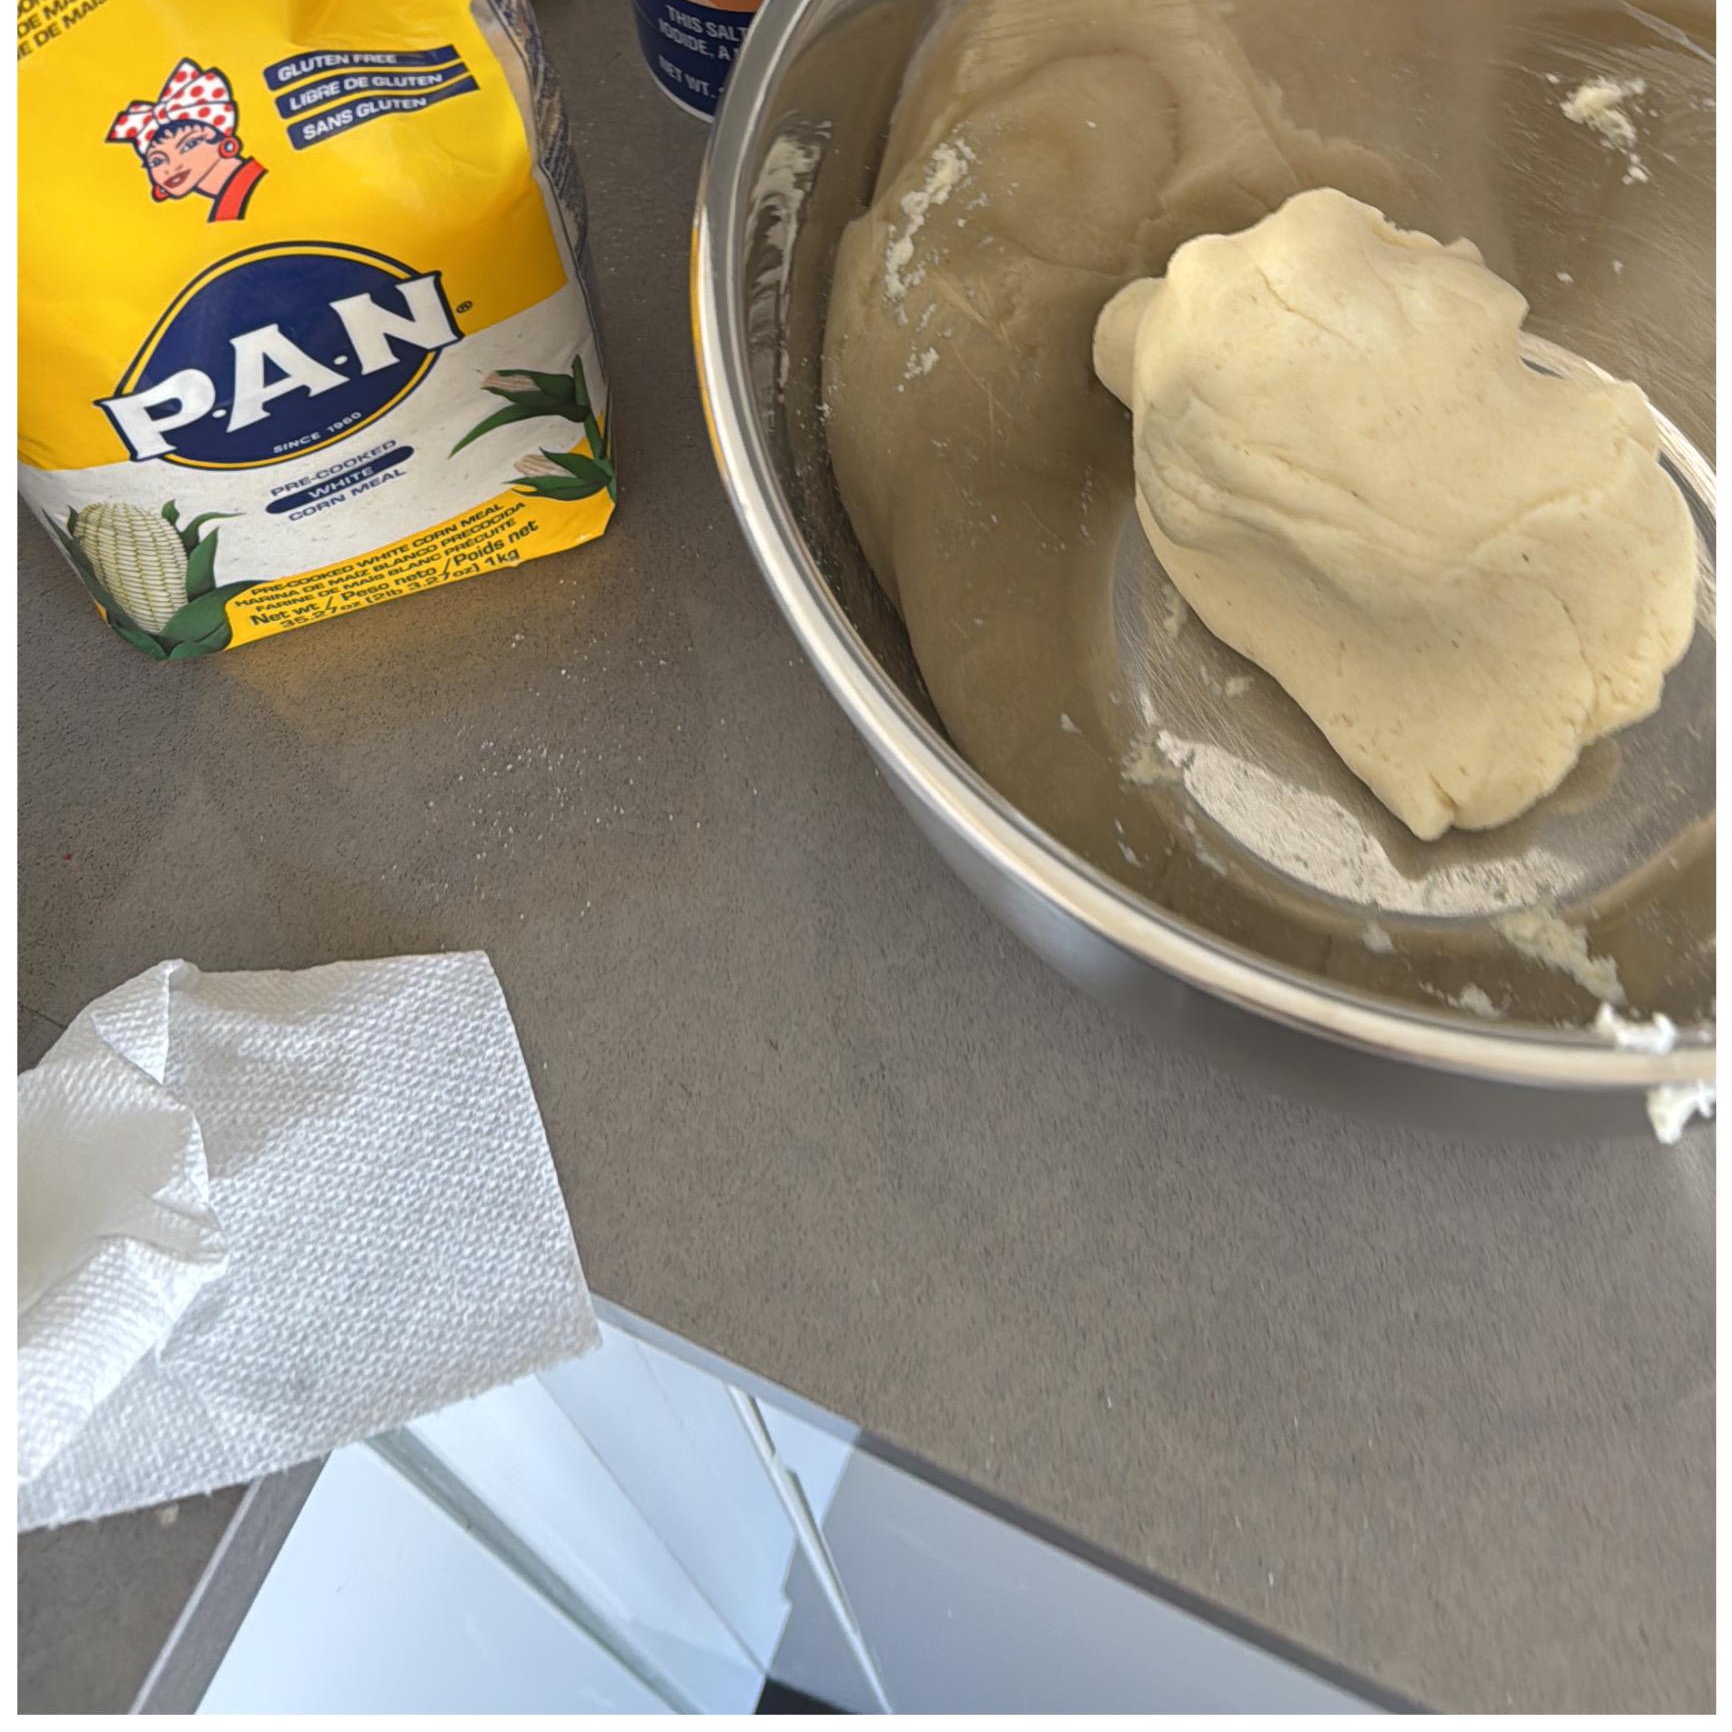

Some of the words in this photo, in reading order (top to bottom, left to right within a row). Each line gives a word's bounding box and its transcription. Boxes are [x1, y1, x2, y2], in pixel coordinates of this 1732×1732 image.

[33, 21, 62, 47] DE
[664, 3, 705, 35] THIS
[276, 52, 351, 82] GLUTEN
[351, 53, 399, 65] FREE
[289, 80, 343, 112] LIBRE
[343, 76, 370, 92] DE
[370, 72, 444, 88] GLUTEN
[302, 107, 354, 141] SANS
[355, 96, 428, 119] GLUTEN
[272, 430, 322, 454] SINCE
[326, 410, 363, 434] 1960
[269, 438, 398, 498] PRE-COOKED
[307, 465, 375, 500] WHITE
[288, 493, 348, 522] CORN
[349, 468, 408, 497] MEAL
[234, 589, 301, 607] HARINA
[301, 581, 326, 594] DE
[372, 543, 439, 573] BLANCO
[440, 501, 527, 548] PRECOCIDA
[356, 543, 410, 568] WHITE
[411, 523, 459, 548] CORN
[460, 504, 505, 528] MEAL
[249, 610, 292, 627] Net
[340, 582, 391, 602] Peso
[393, 567, 438, 586] neto
[452, 538, 506, 567] Poids
[507, 519, 540, 544] net
[255, 593, 316, 613] FARINE
[317, 586, 342, 599] DE
[387, 552, 443, 577] BLANC
